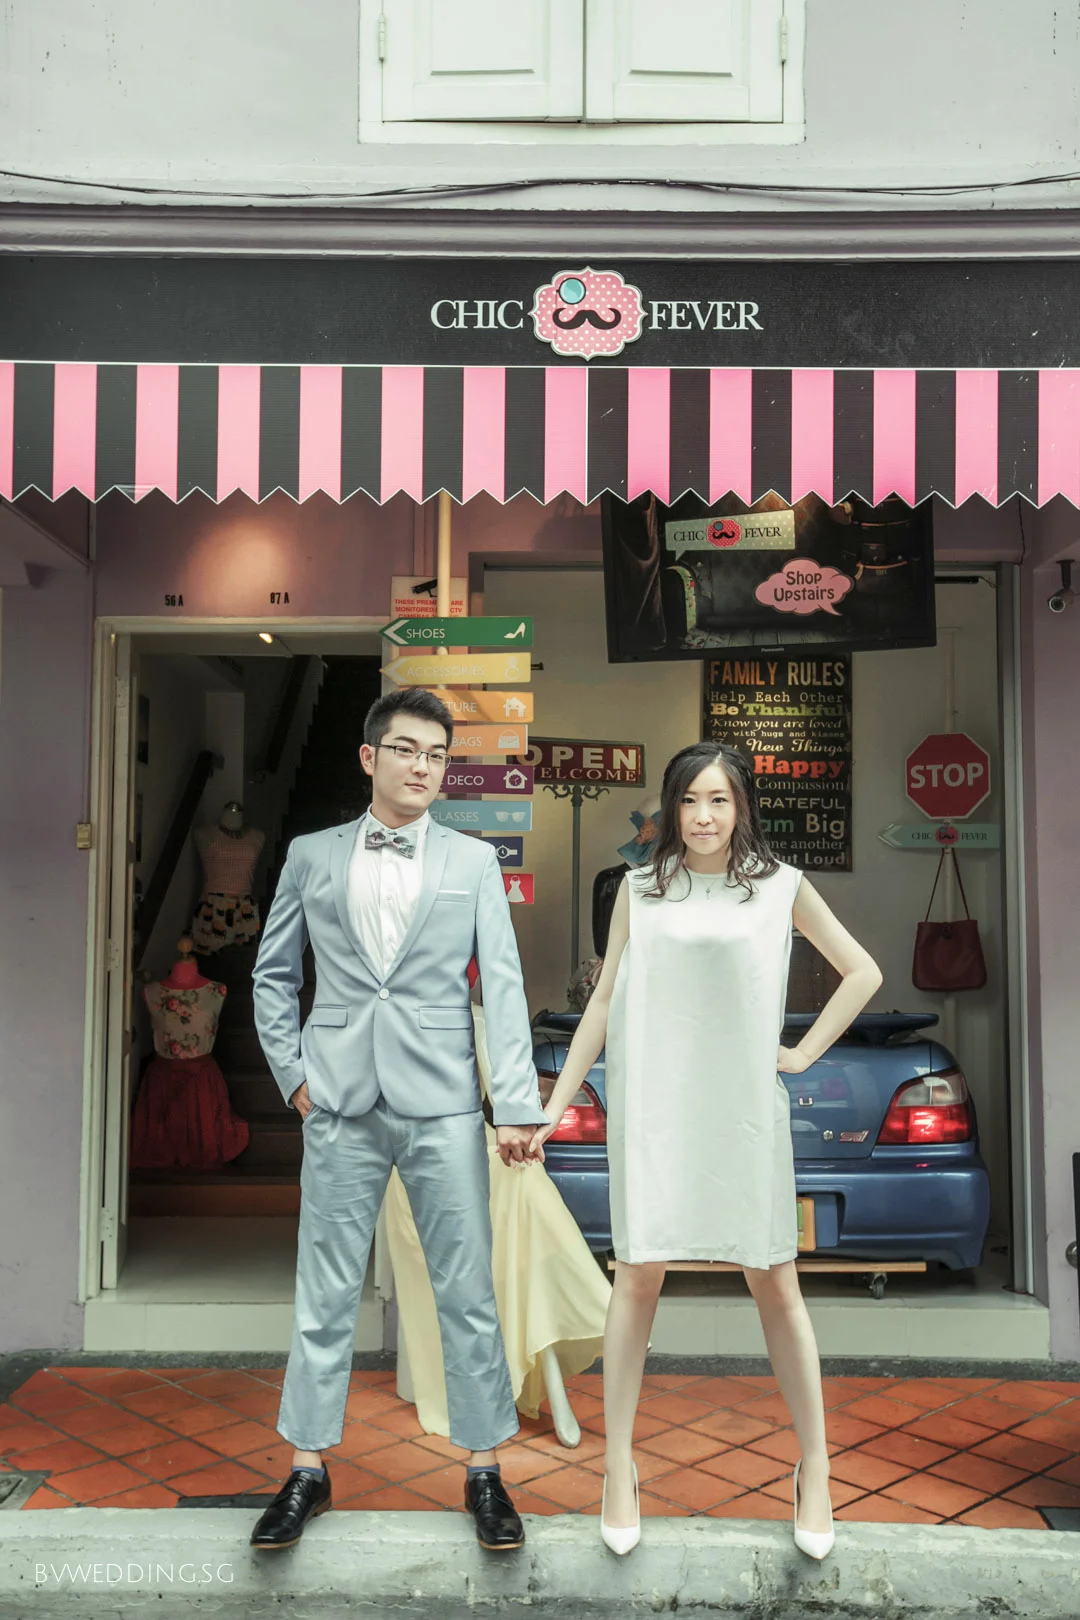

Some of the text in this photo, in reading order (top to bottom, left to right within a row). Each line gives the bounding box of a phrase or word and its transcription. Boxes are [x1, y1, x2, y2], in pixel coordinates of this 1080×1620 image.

[430, 299, 764, 331] CHIC FEVER
[673, 526, 782, 542] CHIC FEVER
[786, 570, 822, 586] Shop
[773, 586, 835, 602] Upstairs
[406, 628, 445, 639] SHOES
[406, 665, 485, 677] ACCESSORIES
[710, 661, 845, 687] FAMILY RULES
[711, 690, 843, 704] Help Each Other
[445, 701, 477, 713] TURE
[711, 703, 844, 716] Be Thankful
[711, 717, 842, 732] Know you are loved
[733, 729, 756, 738] with
[761, 730, 784, 738] hugs
[745, 738, 784, 752] New
[791, 738, 843, 756] Things
[516, 744, 637, 770] OPEN
[534, 767, 637, 781] ELCOME
[753, 755, 845, 779] Happy
[447, 775, 485, 786] DECO
[910, 763, 984, 789] STOP
[755, 776, 844, 794] Compassion
[759, 797, 845, 809] RATEFUL
[806, 813, 845, 840] Big
[790, 837, 844, 850] another
[911, 832, 988, 841] CHIC FEVER
[804, 852, 846, 865] Loud
